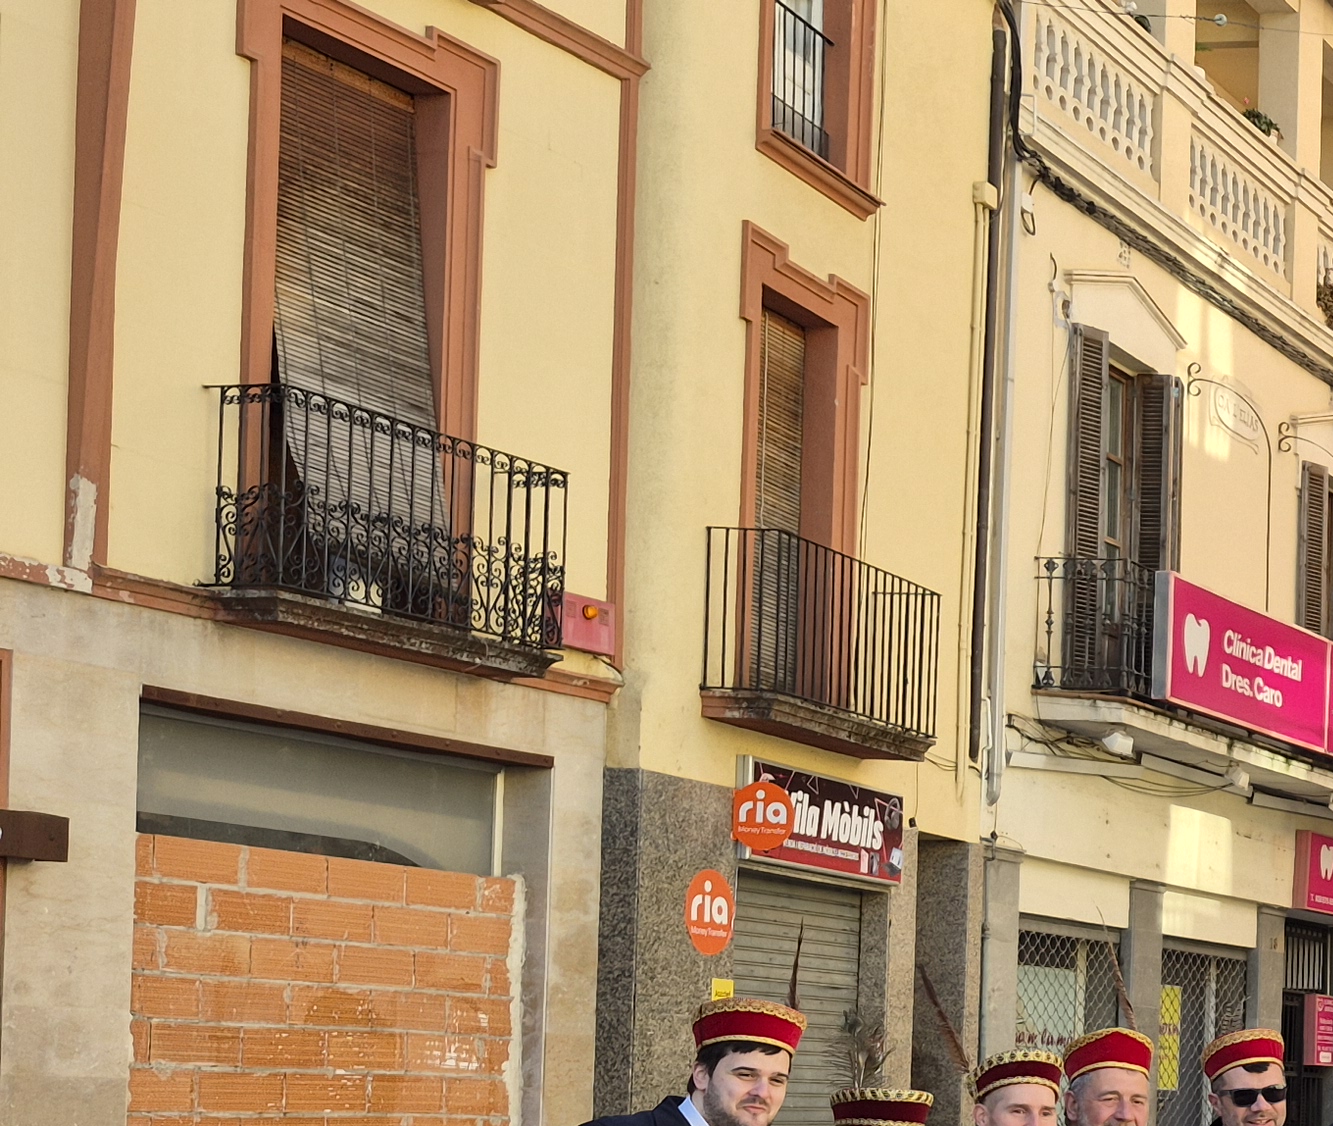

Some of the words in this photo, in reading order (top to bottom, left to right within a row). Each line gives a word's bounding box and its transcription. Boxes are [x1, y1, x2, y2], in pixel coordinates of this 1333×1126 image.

[1223, 629, 1264, 667] Clínica
[1264, 645, 1302, 682] Dental
[1221, 663, 1253, 697] Dres.
[1253, 677, 1283, 708] Caro
[738, 789, 787, 824] ria
[820, 799, 884, 850] Mòbils
[691, 880, 728, 925] ria
